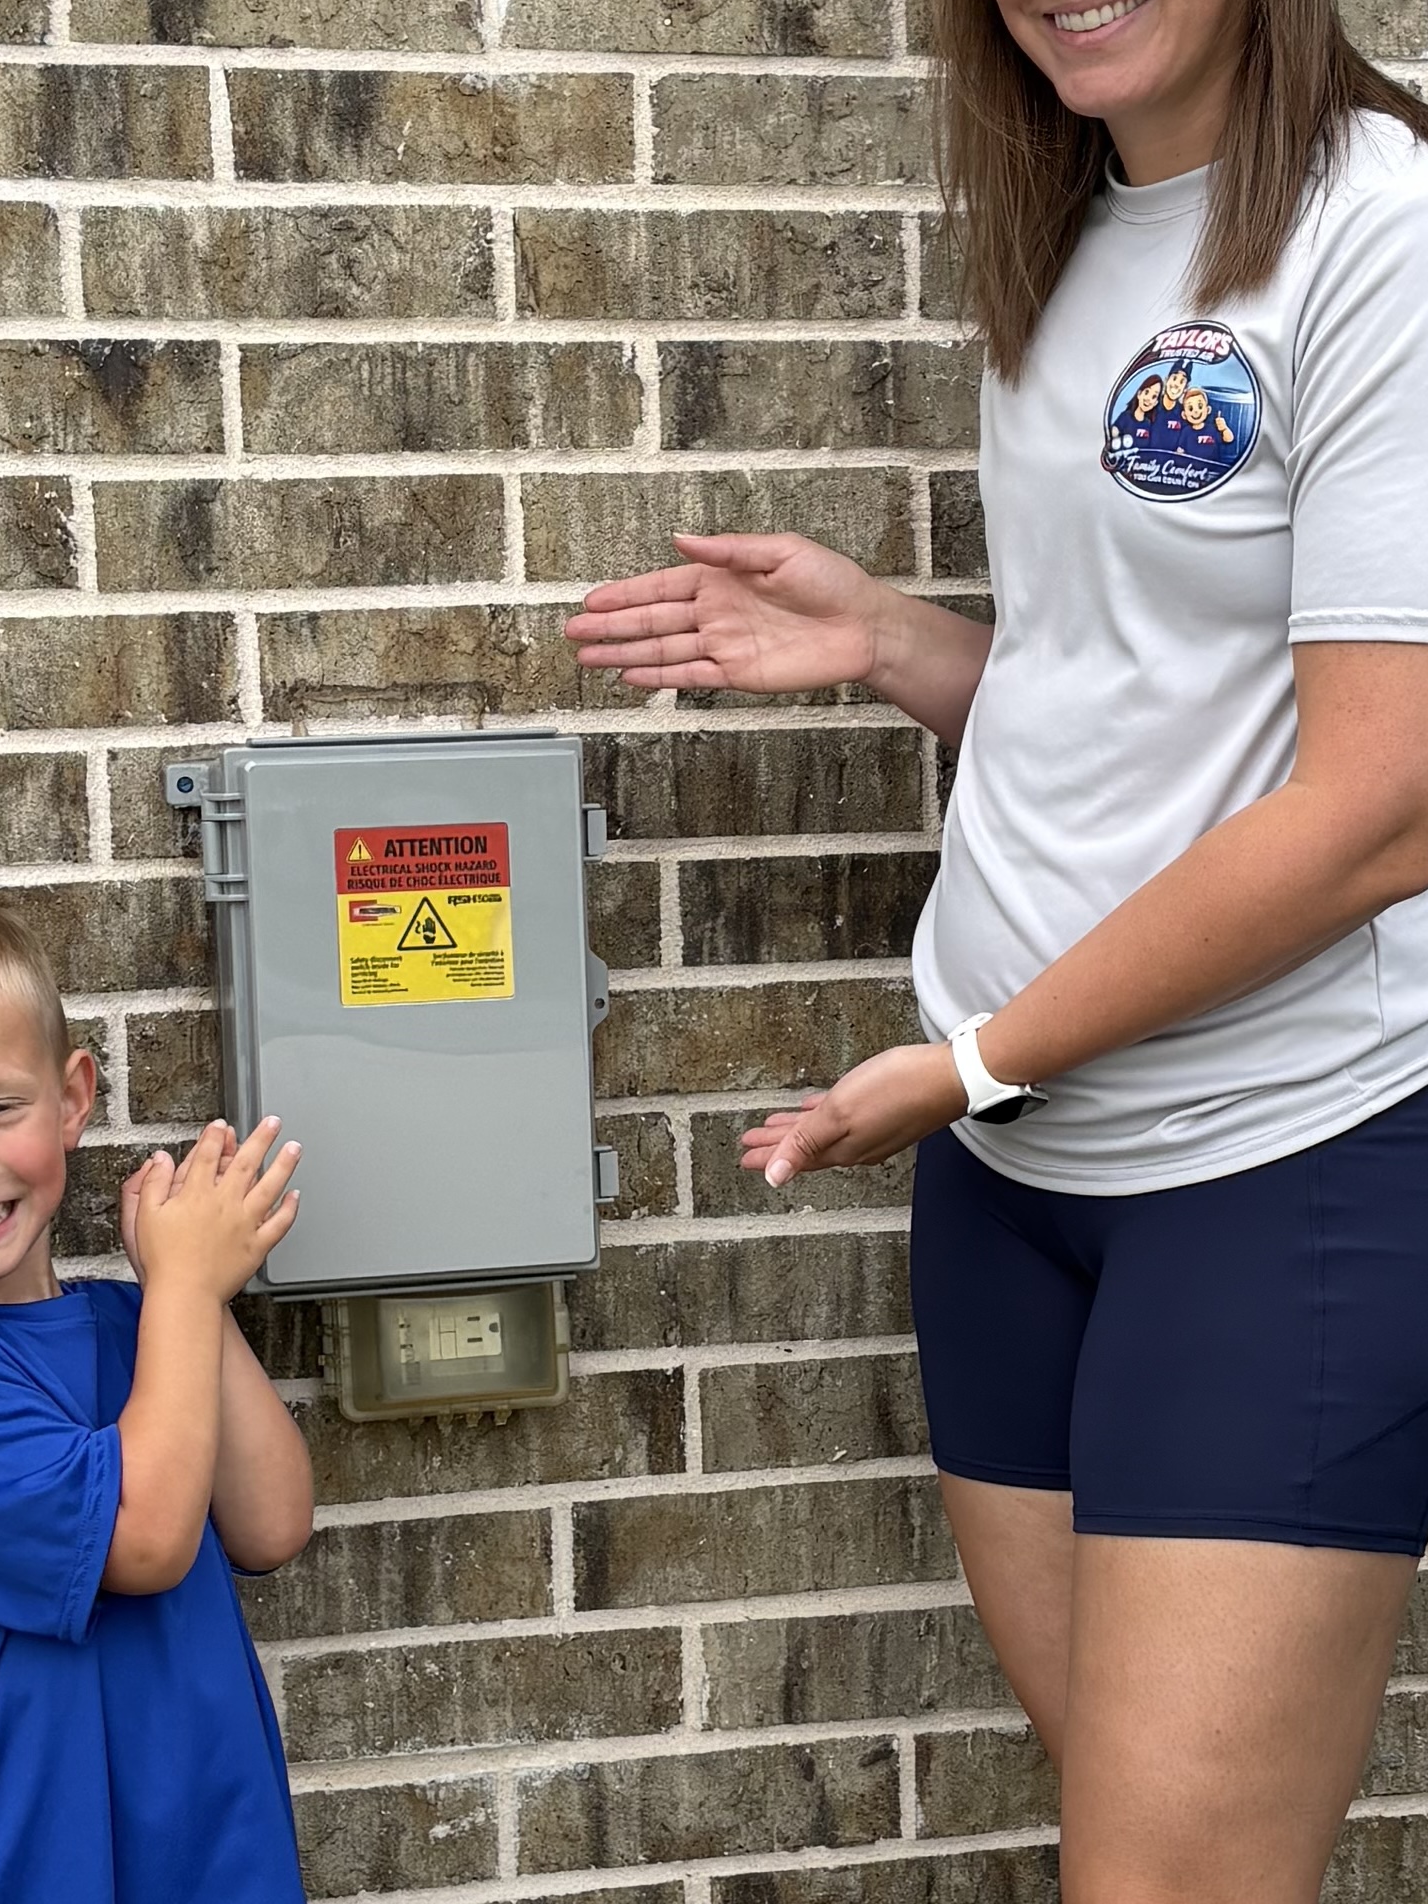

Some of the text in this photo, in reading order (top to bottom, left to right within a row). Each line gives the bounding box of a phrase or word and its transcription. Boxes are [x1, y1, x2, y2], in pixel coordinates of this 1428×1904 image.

[1152, 329, 1233, 356] TAYLOR'S
[1159, 348, 1215, 362] TRUSTED AIR
[1162, 460, 1208, 483] Comfort
[1133, 473, 1147, 481] YOU
[1162, 476, 1186, 486] COUNT
[1187, 480, 1200, 489] ON
[384, 836, 487, 858] ATTENTION
[350, 860, 497, 877] ELECTRICAL SHOCK HAZARD
[347, 872, 501, 890] RISQUE DE CHOC ÉLECTRIQUE
